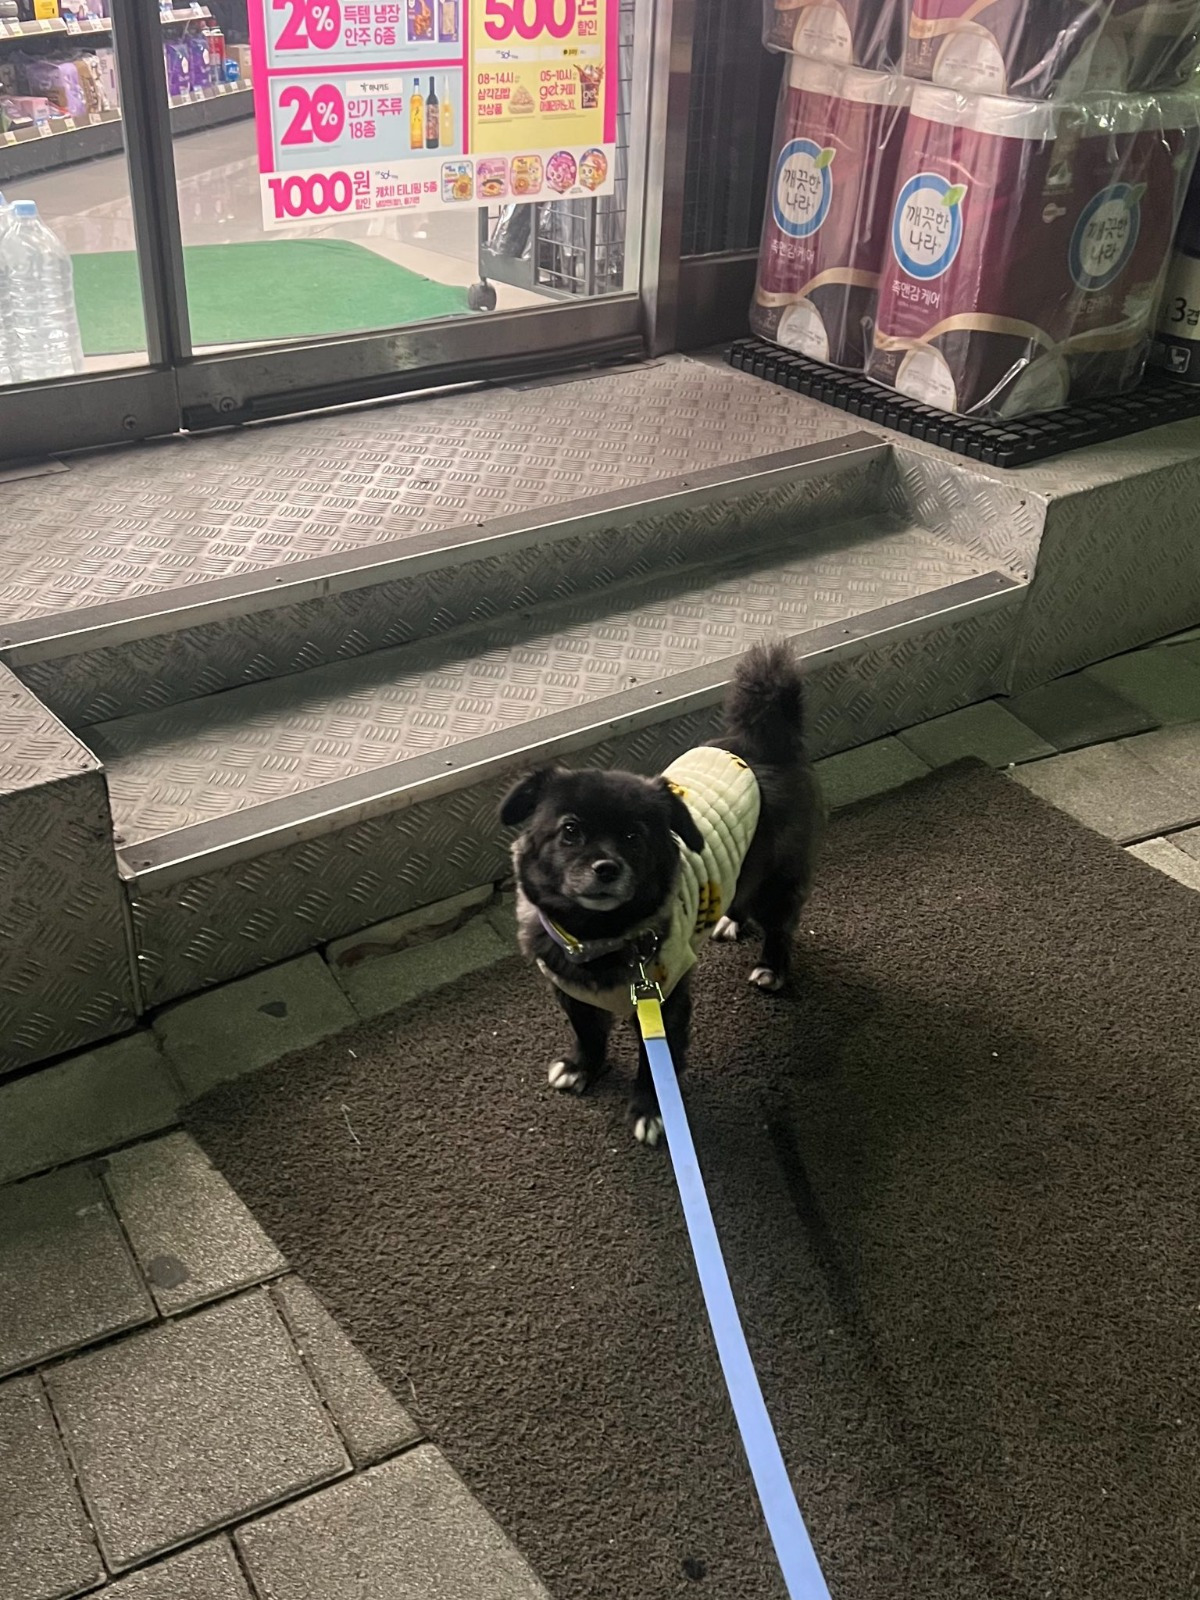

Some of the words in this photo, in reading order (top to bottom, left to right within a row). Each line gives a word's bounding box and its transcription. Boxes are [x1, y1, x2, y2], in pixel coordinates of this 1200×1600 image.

[344, 5, 370, 25] 득템
[374, 4, 401, 24] 냉장
[484, 0, 576, 41] 500
[344, 27, 371, 47] 안주
[374, 27, 396, 46] 6종
[577, 20, 597, 36] 할인
[478, 72, 514, 85] 08-14시
[540, 69, 572, 82] 05-10시
[478, 87, 511, 101] 삼각김밥
[539, 82, 558, 100] get
[560, 83, 576, 96] 커피
[279, 84, 345, 146] 20%
[347, 99, 374, 119] 인기
[376, 97, 403, 116] 주류
[478, 103, 503, 116] 전상품
[349, 120, 376, 140] 18종
[353, 170, 370, 196] 원
[424, 181, 438, 193] 5종
[783, 168, 821, 195] 깨끗한
[268, 171, 353, 218] 1000
[355, 198, 371, 210] 할인
[785, 194, 811, 215] 나라
[906, 205, 950, 234] 깨끗한
[1087, 217, 1128, 241] 깨끗한
[909, 230, 938, 256] 나라
[1090, 243, 1117, 264] 나라
[1169, 297, 1200, 326] 3겹
